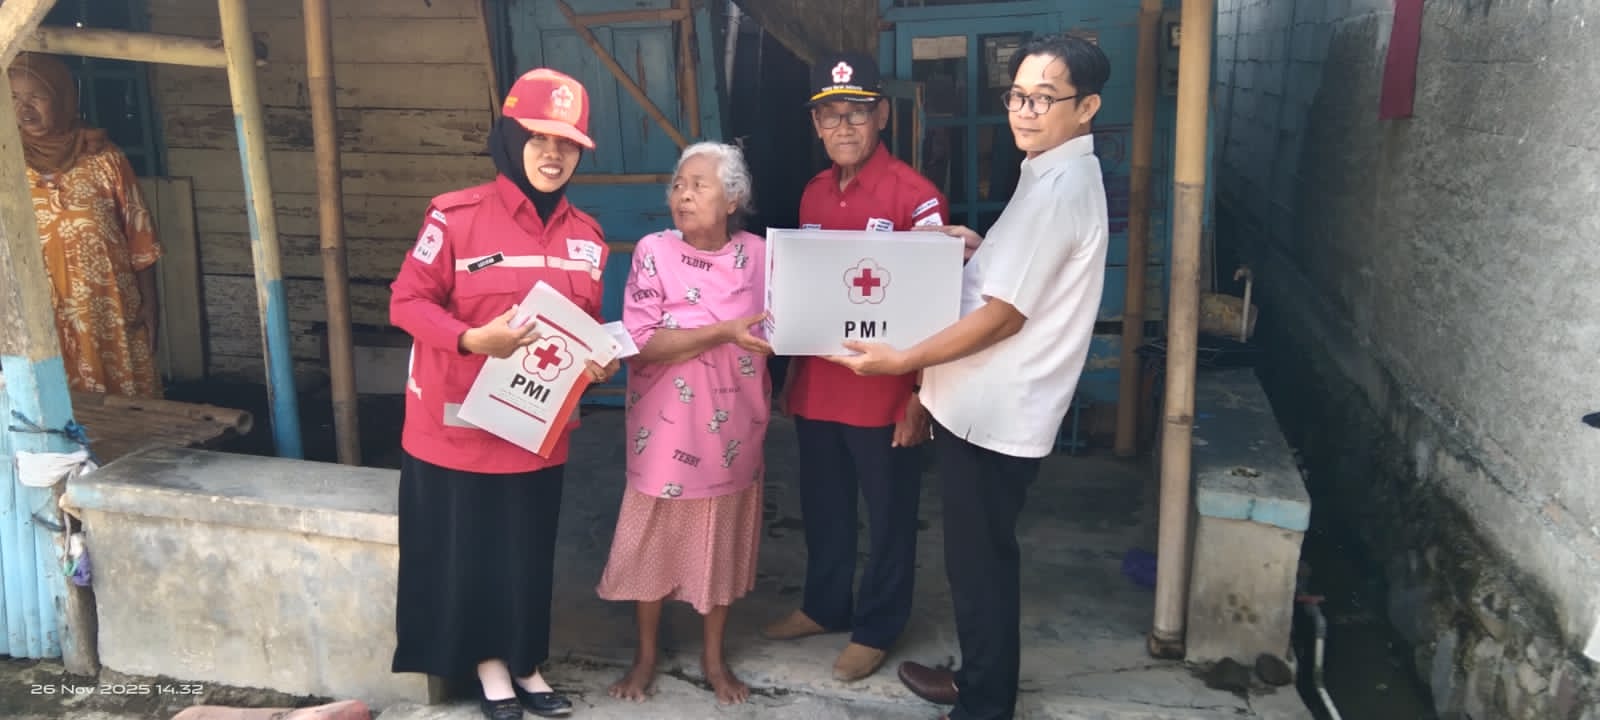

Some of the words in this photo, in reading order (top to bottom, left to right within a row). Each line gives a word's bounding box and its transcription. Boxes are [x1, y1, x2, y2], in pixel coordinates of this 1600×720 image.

[681, 254, 714, 272] TEDDY
[844, 321, 888, 338] PMI
[510, 374, 551, 404] PMI
